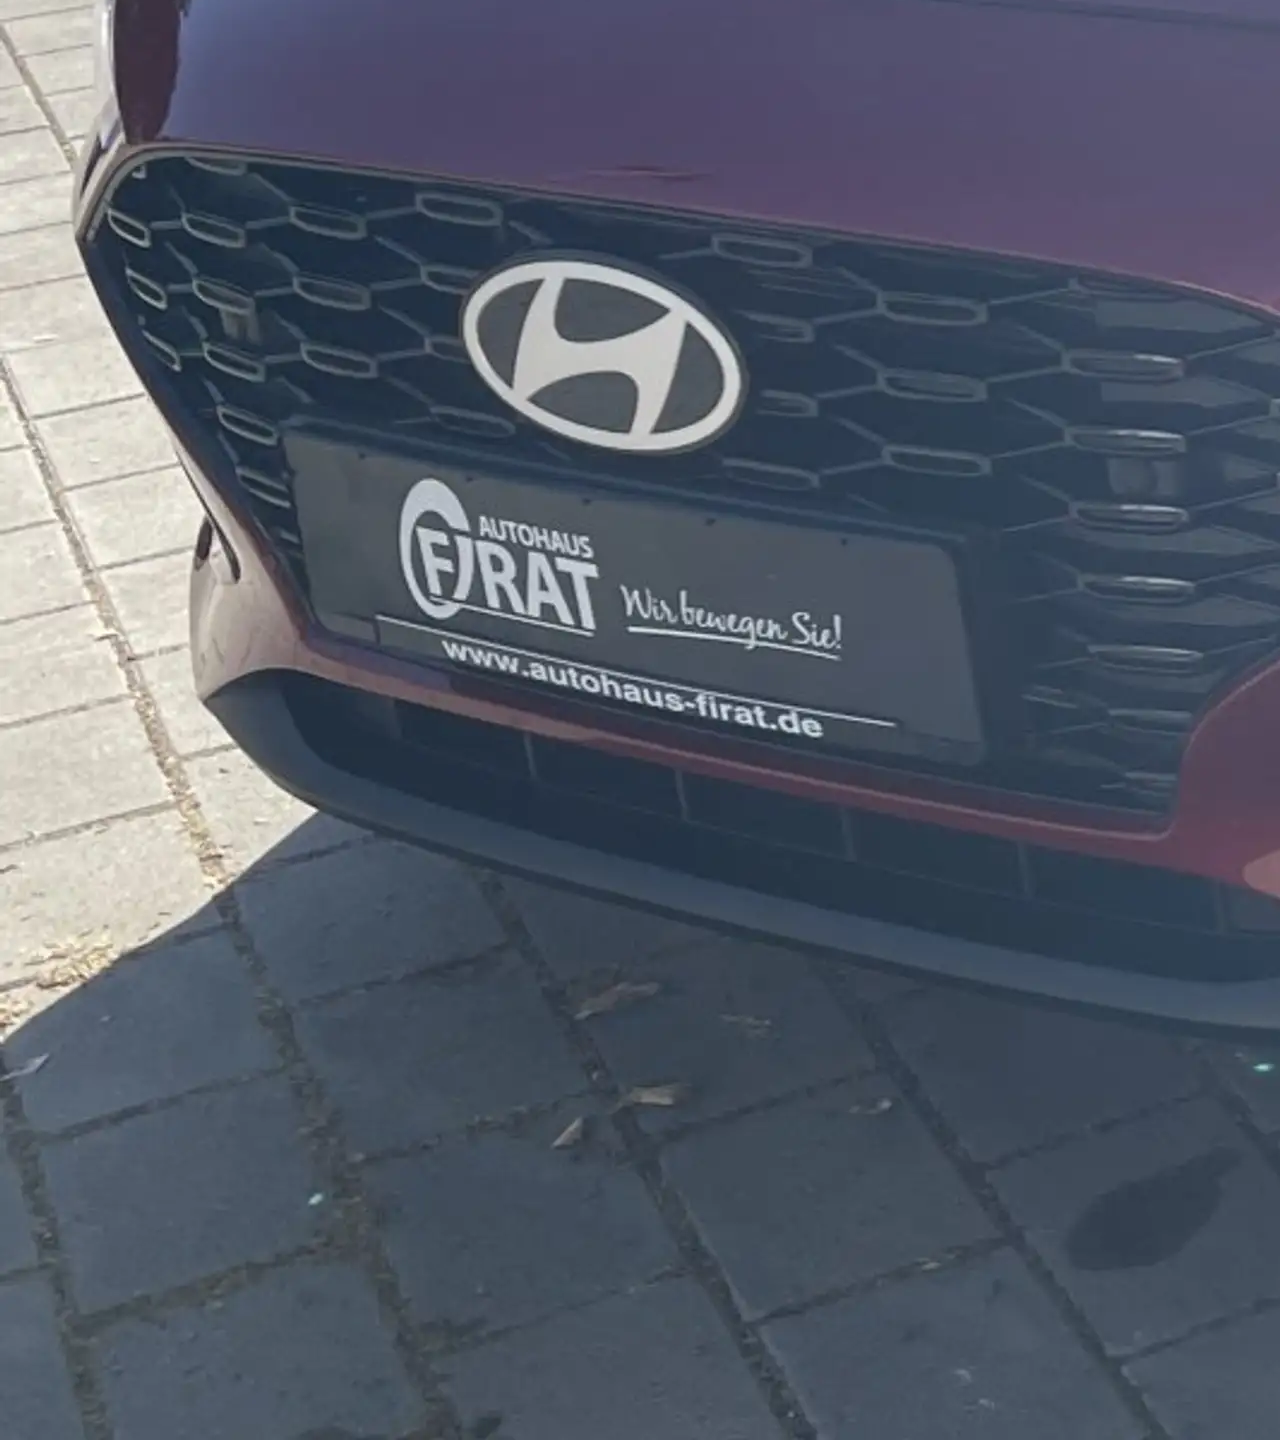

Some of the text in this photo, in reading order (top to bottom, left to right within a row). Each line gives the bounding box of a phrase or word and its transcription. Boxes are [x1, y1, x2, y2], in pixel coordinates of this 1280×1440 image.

[414, 523, 600, 631] FIRAT
[478, 515, 595, 559] AUTOHAUS
[620, 584, 842, 649] Wir bewegen Sie!
[441, 639, 824, 738] www.autohaus-firat.de
